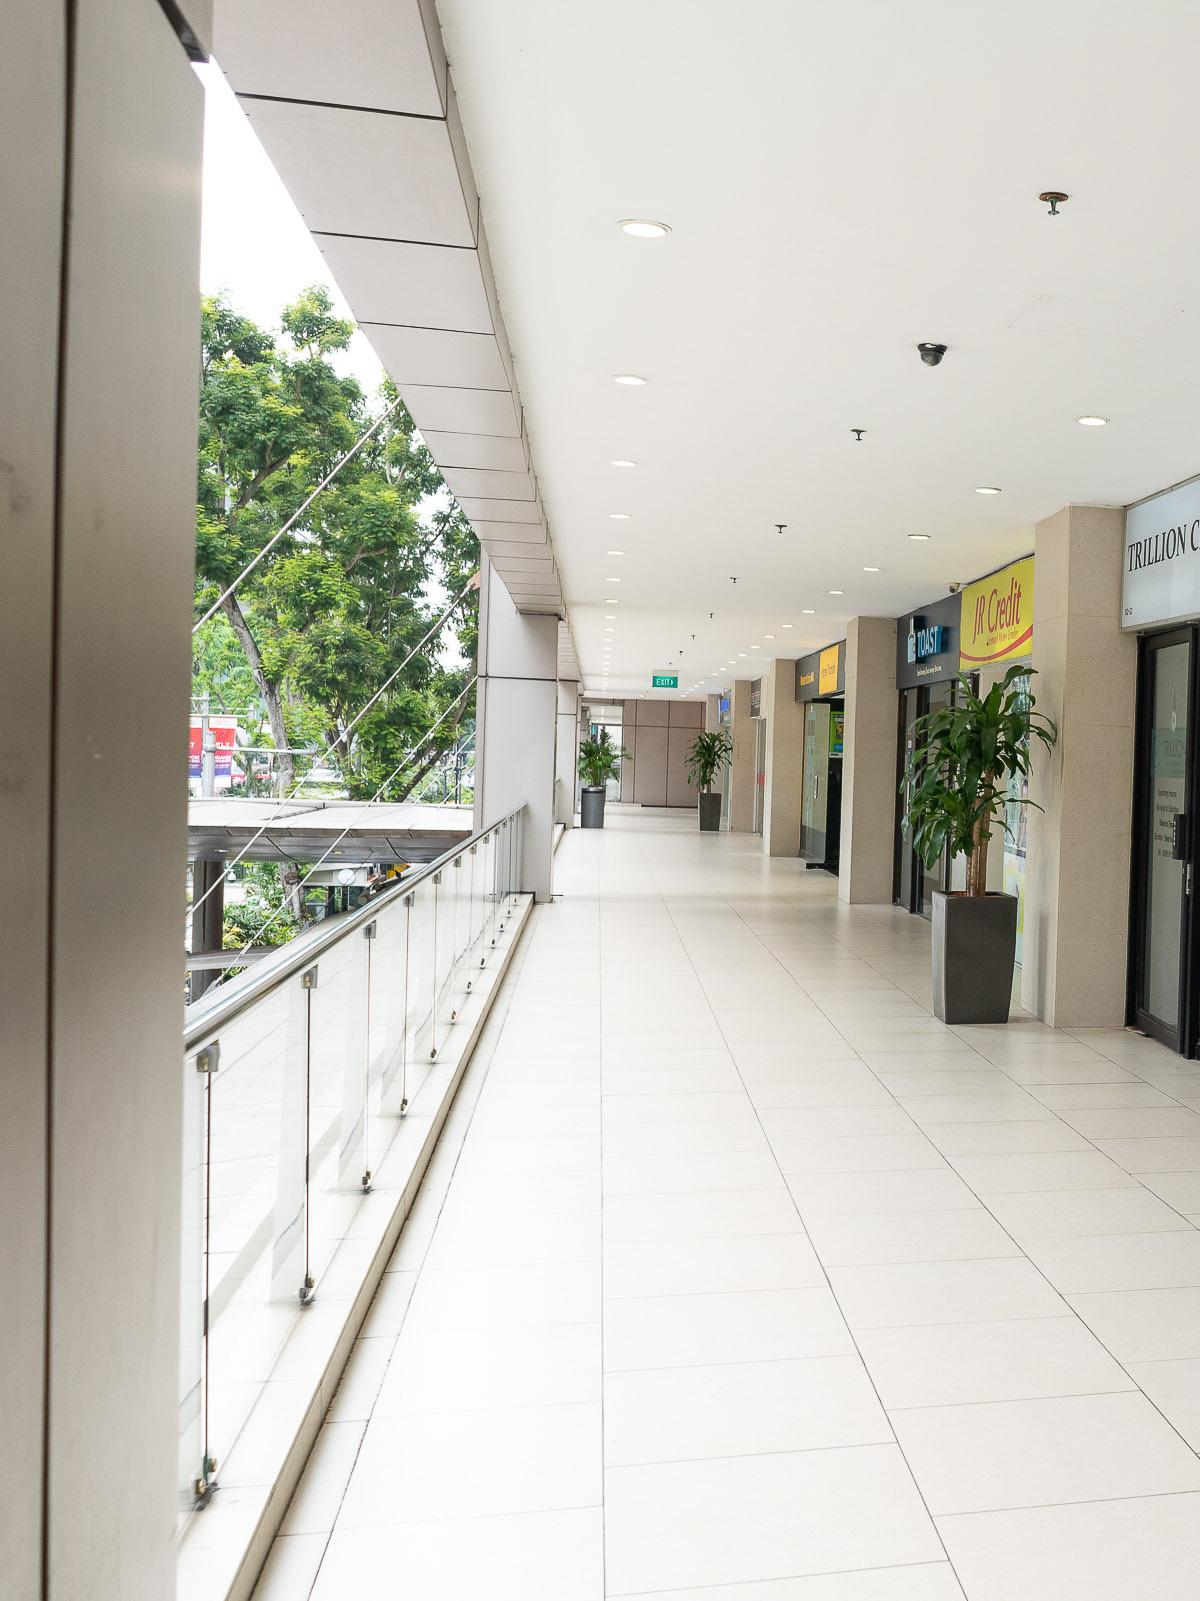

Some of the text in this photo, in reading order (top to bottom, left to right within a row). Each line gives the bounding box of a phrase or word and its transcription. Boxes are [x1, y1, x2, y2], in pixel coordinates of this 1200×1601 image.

[1128, 524, 1187, 573] TRILLION
[973, 577, 1022, 645] JR Credit
[917, 626, 940, 657] TOAST
[656, 678, 670, 686] EXIT
